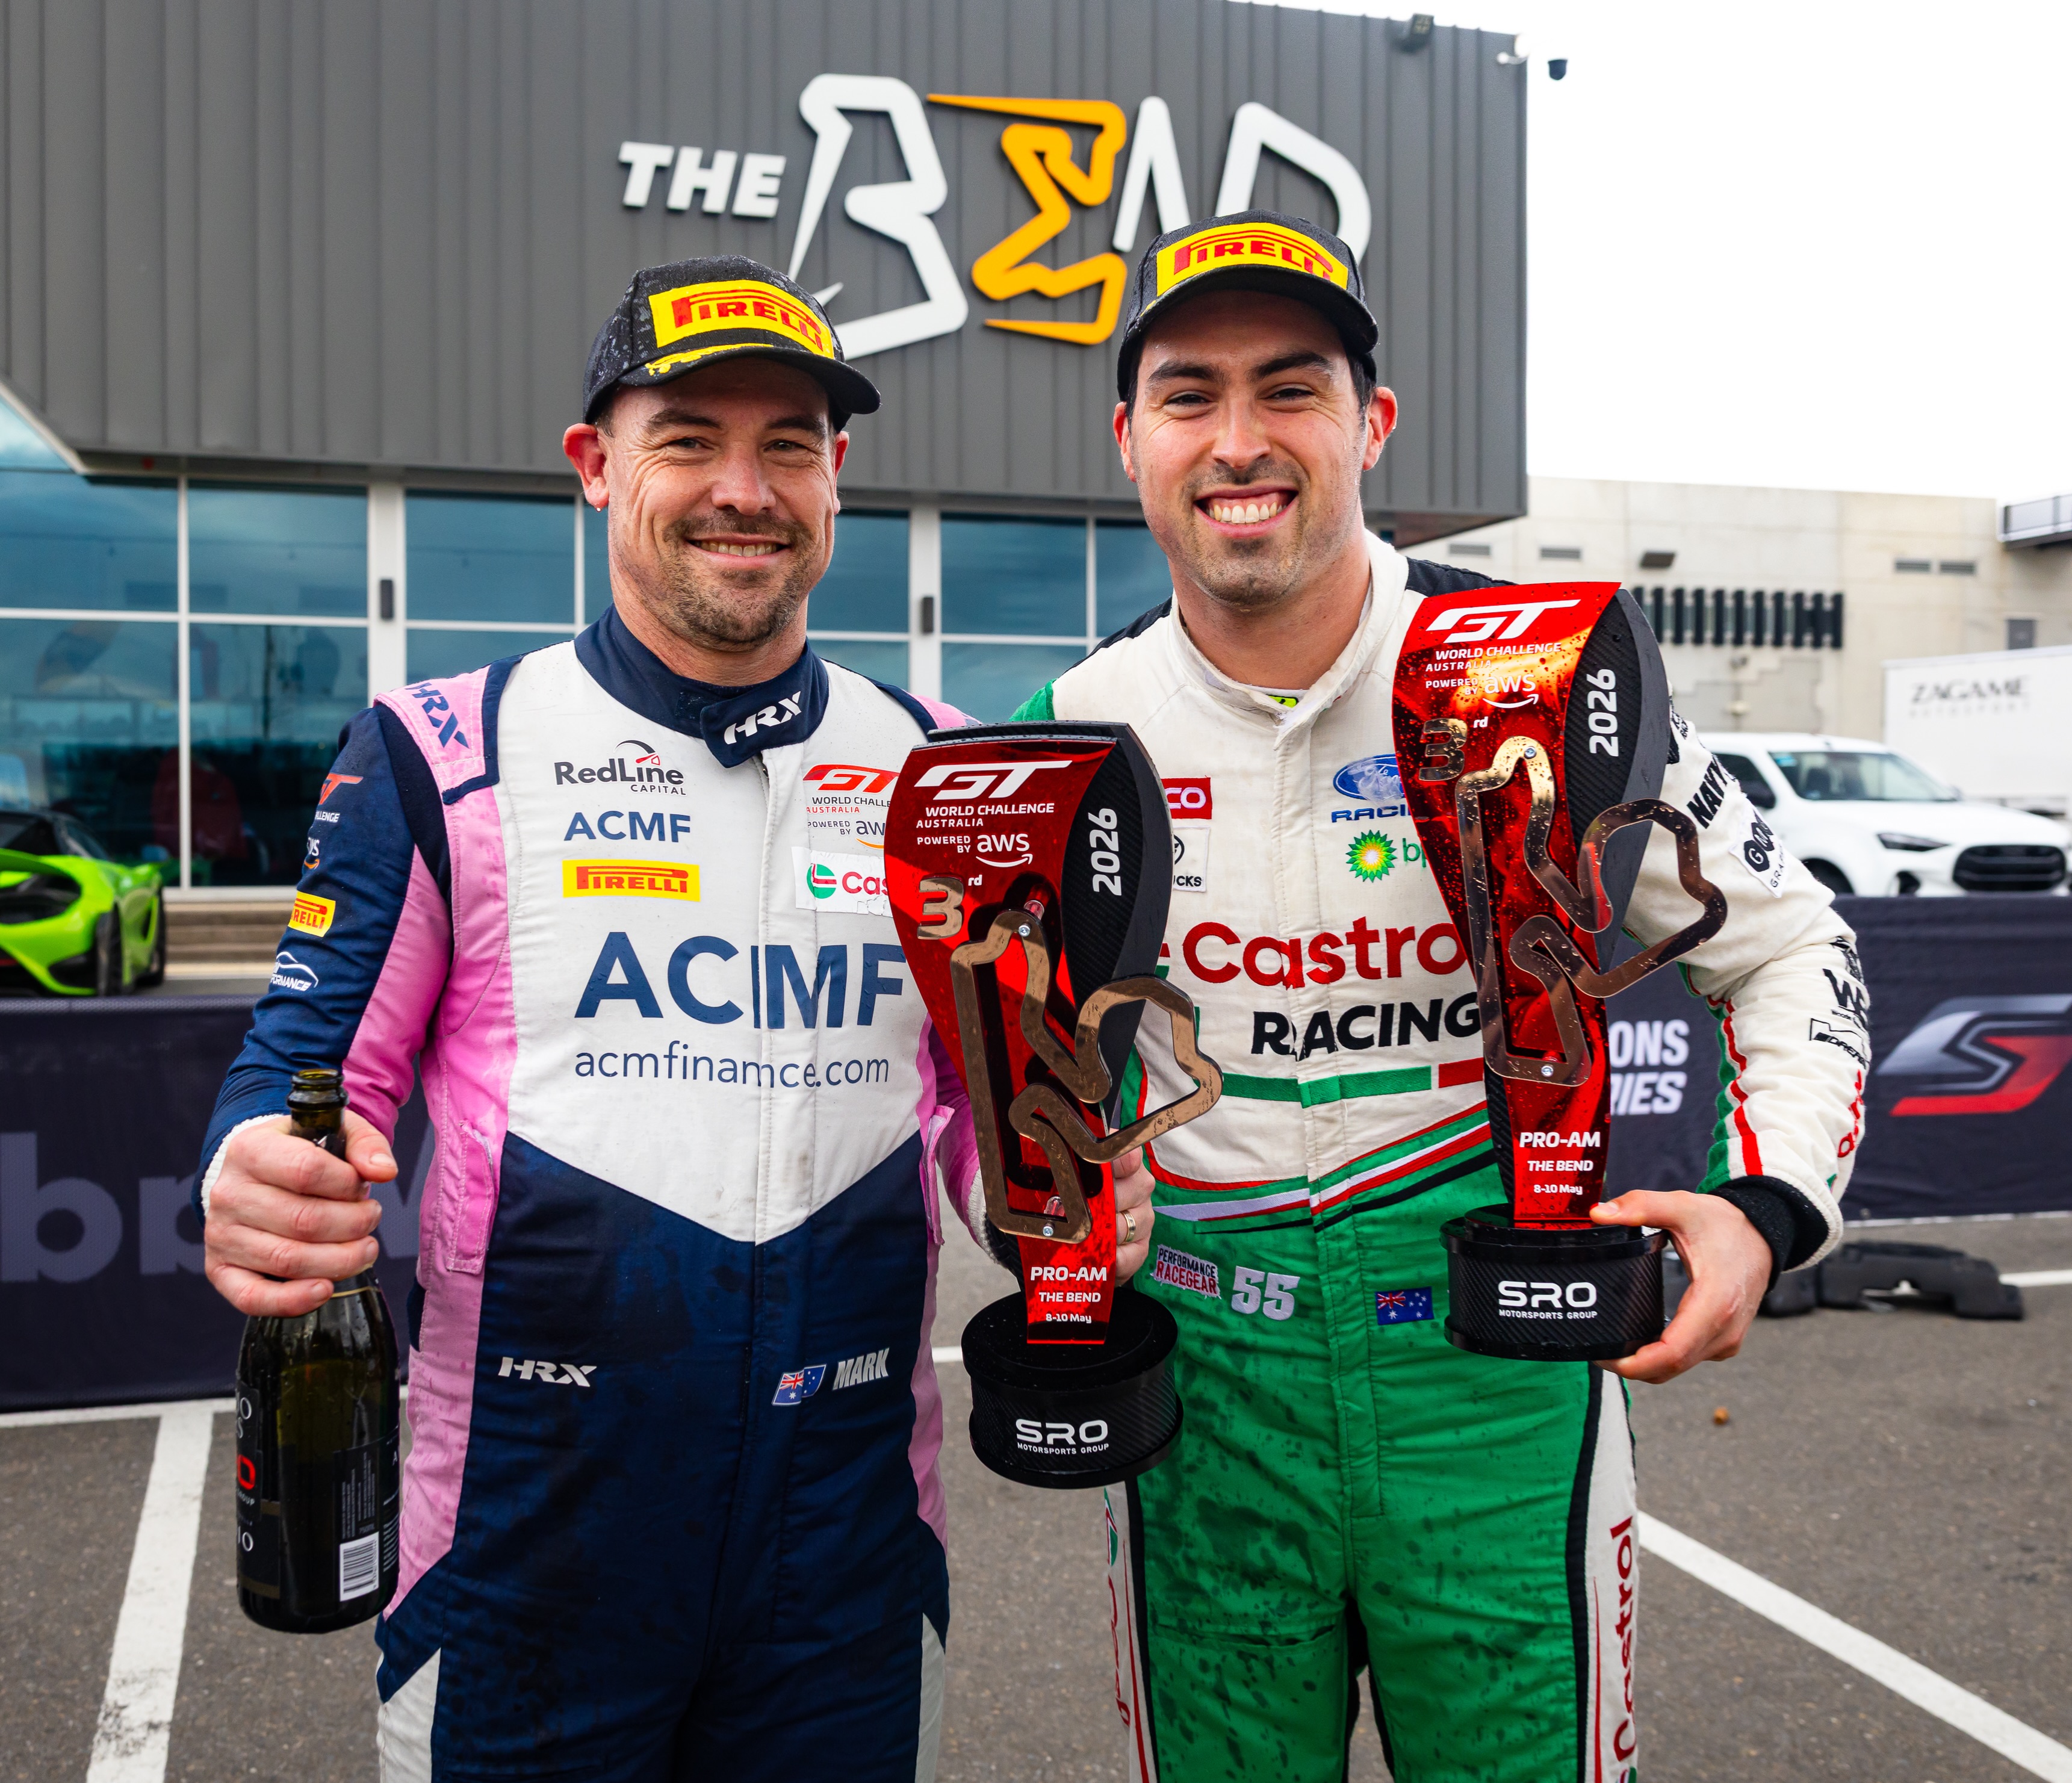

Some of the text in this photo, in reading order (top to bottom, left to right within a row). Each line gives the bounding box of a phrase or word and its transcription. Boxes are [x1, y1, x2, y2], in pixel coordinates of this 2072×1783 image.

[618, 141, 786, 219] THE
[671, 289, 822, 351] PIRELLI
[1425, 599, 1581, 643] GT
[1436, 642, 1562, 660] WORLD CHALLENGE
[1425, 660, 1492, 672] AUSTRALIA
[1425, 674, 1536, 695] POWERED aws
[1465, 687, 1478, 695] BY
[404, 682, 470, 749] HRX
[724, 691, 802, 745] HRX
[1587, 668, 1619, 757] 2026
[554, 758, 684, 786] RedLine
[914, 760, 1073, 800] GT
[630, 785, 687, 796] CAPITAL
[812, 796, 851, 805] WORLD
[916, 817, 984, 829] AUSTRALIA
[926, 802, 1055, 817] WORLD CHALLENGE
[564, 810, 690, 843] ACMF
[916, 833, 1031, 853] POWERED aws
[957, 845, 971, 854] BY
[1088, 808, 1123, 896] 2026
[576, 866, 689, 893] PIRELLI
[1173, 875, 1203, 887] CKS
[574, 931, 906, 1029] ACMF
[1251, 991, 1483, 1061] RACING
[574, 1040, 889, 1088] acmfinance.com
[1519, 1131, 1601, 1148] PRO-AM
[1527, 1160, 1593, 1171] THE BEND
[1533, 1184, 1583, 1195] 8-10 May
[1030, 1267, 1107, 1282] PRO-AM
[1158, 1247, 1217, 1279] PERFORMANCE
[1156, 1261, 1218, 1295] RACEGEAR
[1039, 1292, 1101, 1303] THE BEND
[1231, 1265, 1300, 1321] 55
[1498, 1280, 1597, 1308] SRO
[1046, 1313, 1092, 1324] 8-10 May
[1499, 1309, 1598, 1319] MOTORSPORTS GROUP
[498, 1357, 597, 1387] HRX
[832, 1347, 890, 1391] MARK
[1016, 1418, 1108, 1445] SRO
[1017, 1443, 1109, 1455] MOTORSPORTS GROUP
